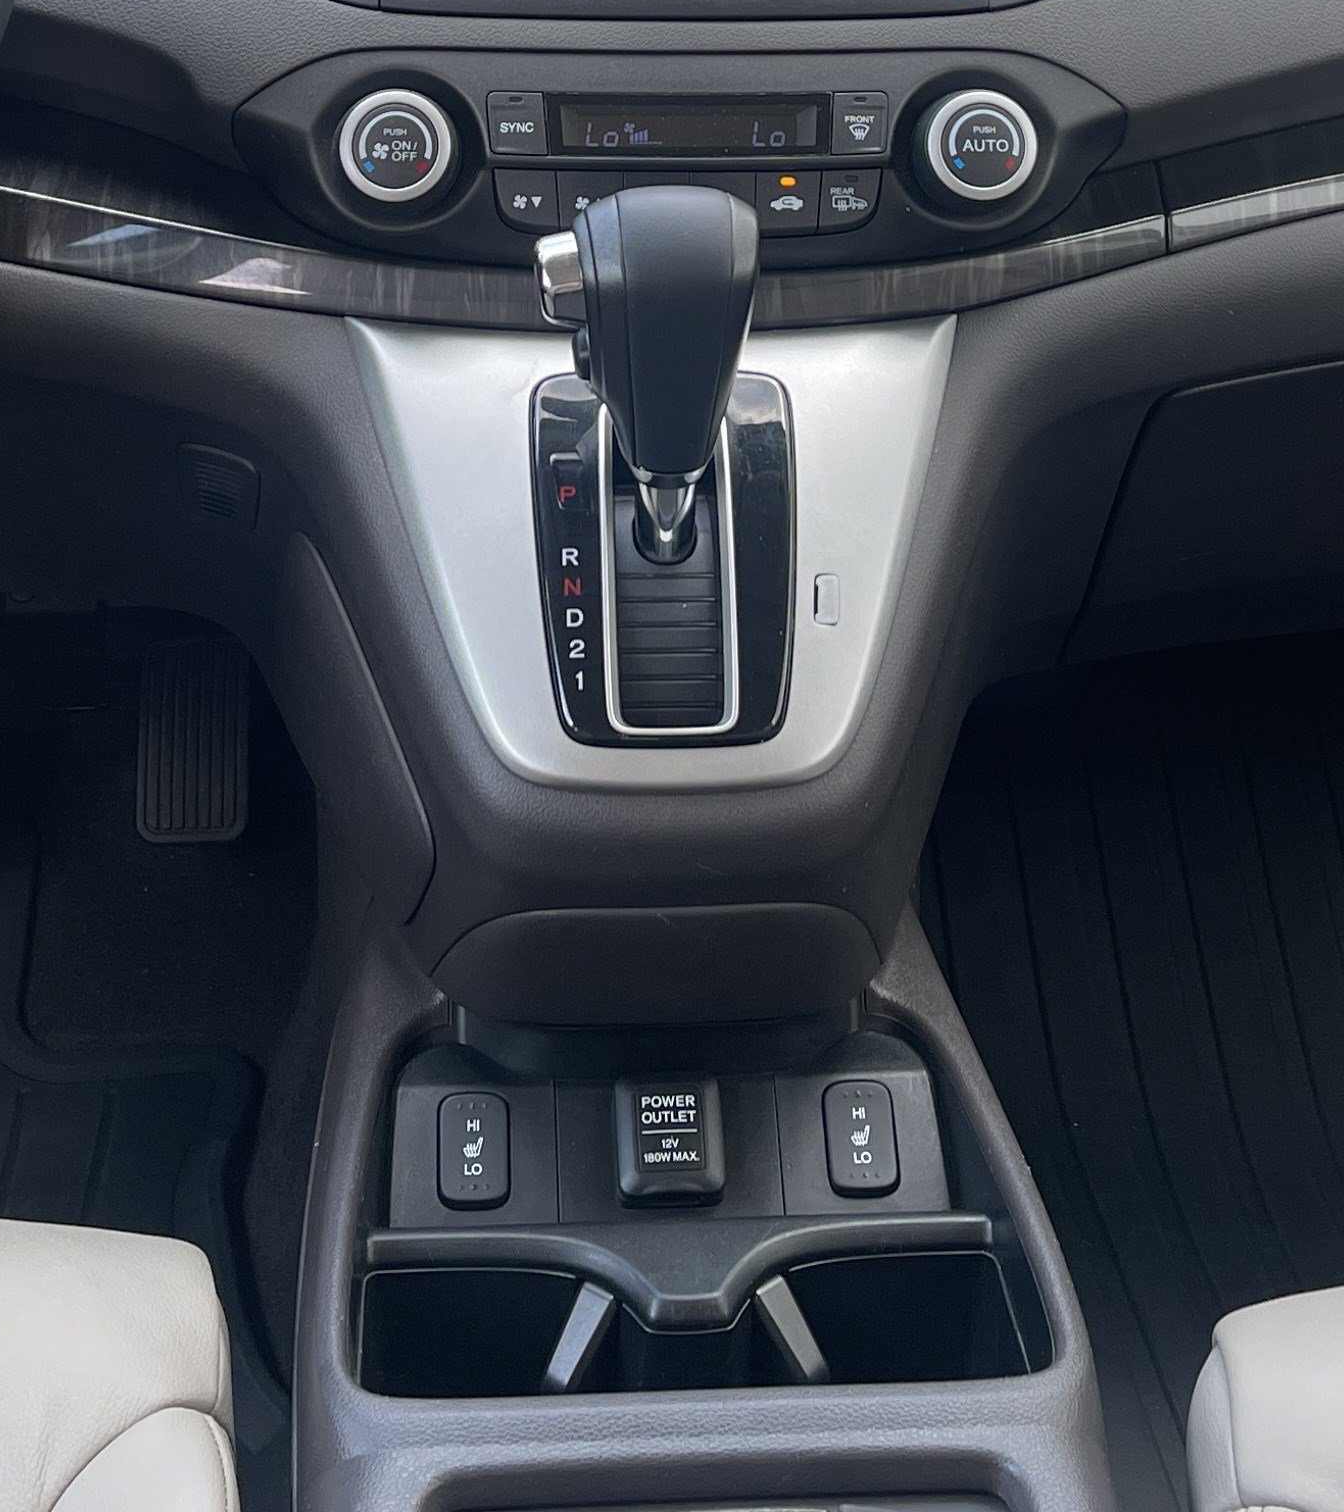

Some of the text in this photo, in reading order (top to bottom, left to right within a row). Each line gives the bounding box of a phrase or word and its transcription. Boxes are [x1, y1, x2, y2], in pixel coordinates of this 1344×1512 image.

[844, 115, 874, 124] FRONT
[383, 128, 408, 136] PUSH
[499, 121, 534, 134] SYNC
[972, 125, 997, 134] PUSH
[962, 139, 1010, 152] AUTO
[391, 151, 418, 162] OFF
[830, 187, 855, 195] REAR
[559, 486, 577, 503] P
[562, 548, 579, 567] R
[563, 578, 581, 597] N
[566, 608, 584, 628] D
[569, 639, 585, 658] 2
[575, 671, 584, 691] 1
[641, 1094, 696, 1109] POWER
[641, 1110, 696, 1125] OUTLET
[852, 1108, 866, 1120] HI
[466, 1120, 480, 1132] HI
[661, 1138, 679, 1149] 12V
[643, 1150, 700, 1164] 180W MAX.
[853, 1151, 872, 1164] LO
[464, 1163, 483, 1176] LO
